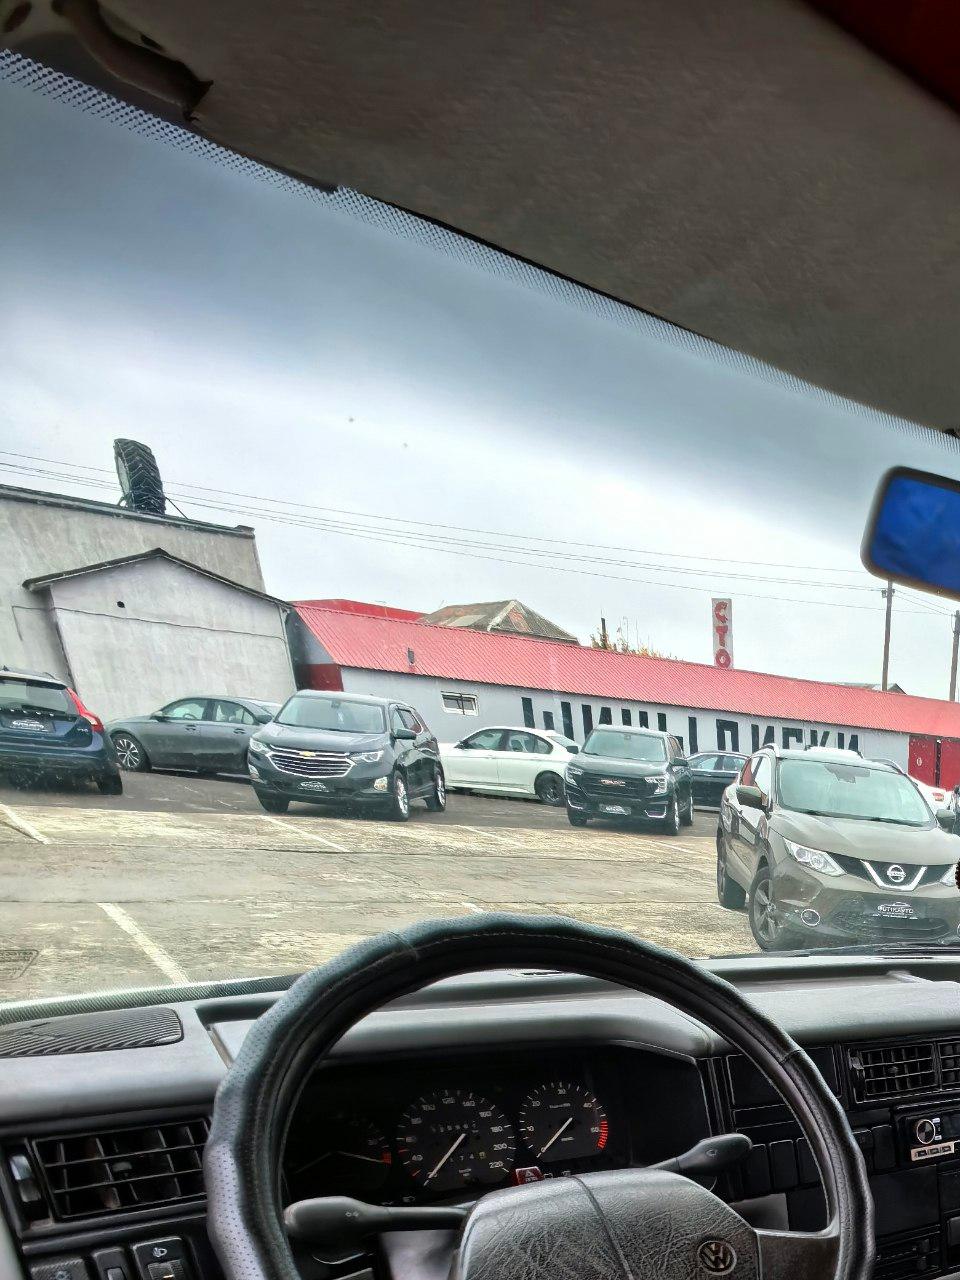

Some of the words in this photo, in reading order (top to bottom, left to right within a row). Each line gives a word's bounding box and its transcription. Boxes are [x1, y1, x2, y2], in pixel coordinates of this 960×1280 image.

[714, 601, 731, 669] СТО
[493, 1142, 508, 1151] 200
[489, 1160, 504, 1169] 220
